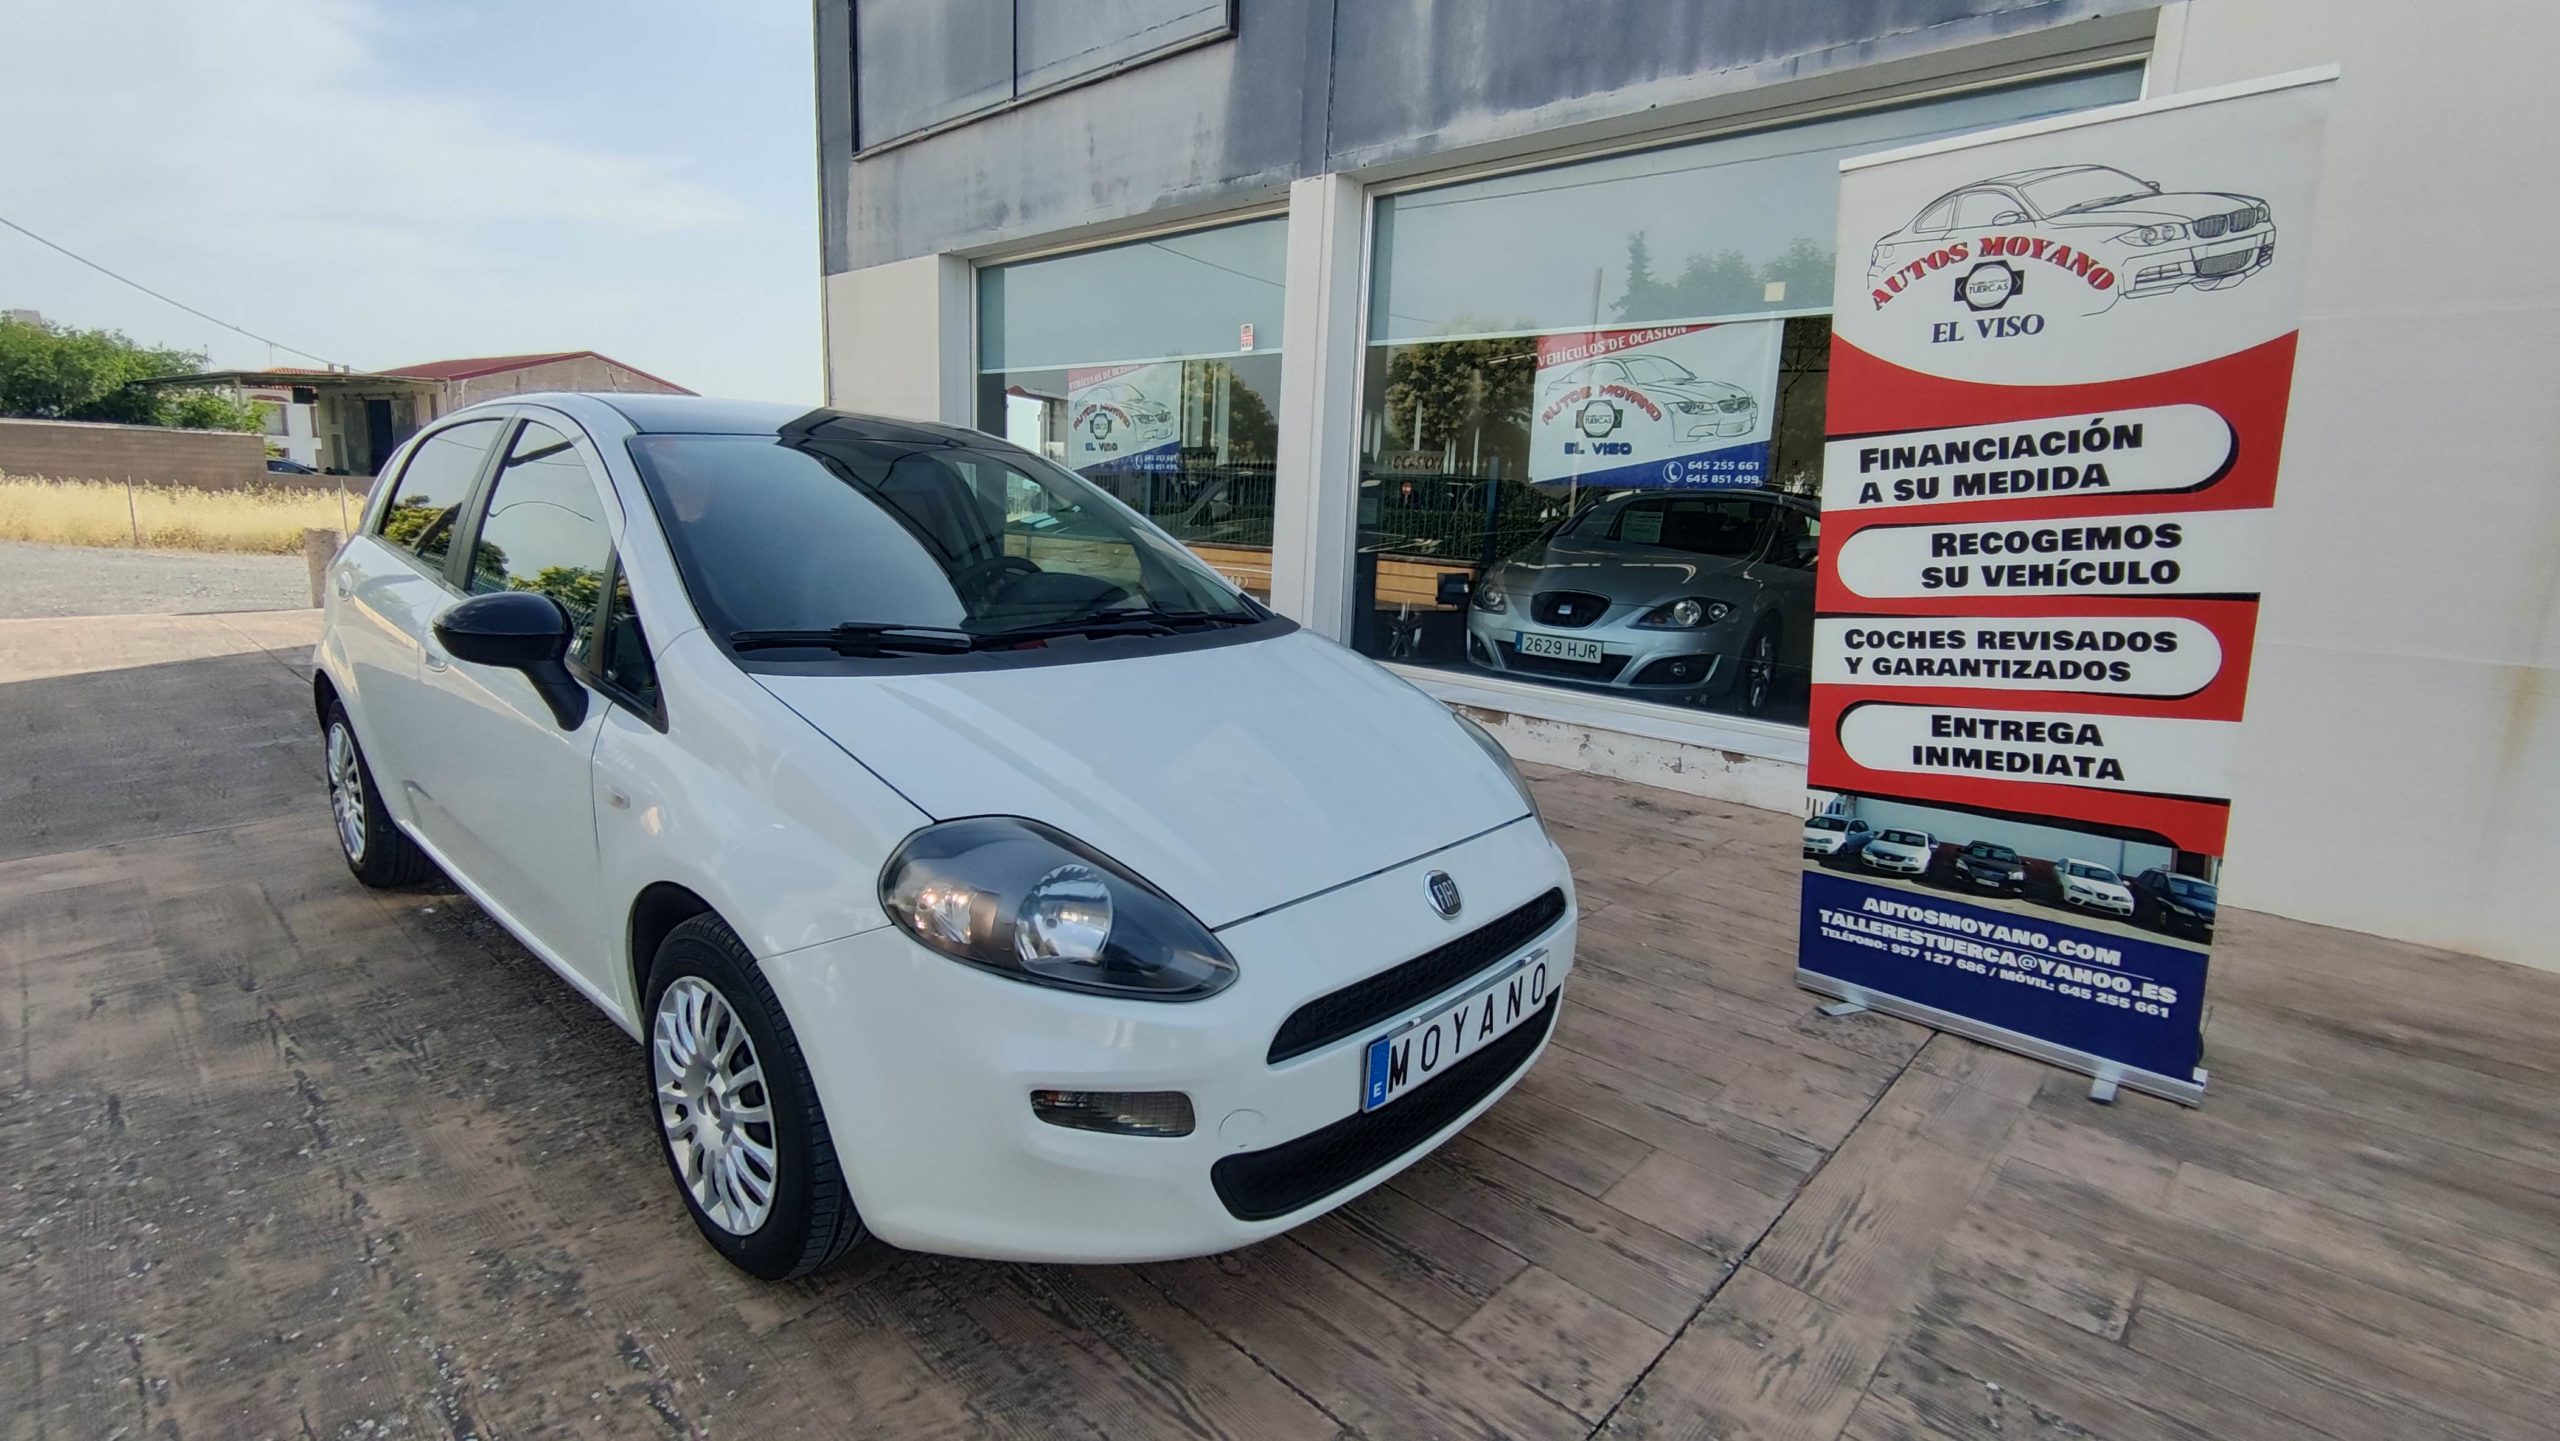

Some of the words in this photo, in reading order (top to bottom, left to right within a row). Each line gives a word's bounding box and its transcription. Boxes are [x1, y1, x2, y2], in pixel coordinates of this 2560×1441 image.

[1869, 241, 1969, 311] AUTOS
[1979, 236, 2115, 291] MOYANO
[1608, 336, 1625, 351] DE
[1931, 321, 1964, 343] EL
[1976, 313, 2045, 338] VISO
[1542, 385, 1593, 426] AUTOS
[1599, 384, 1662, 422] MOYANO
[1564, 442, 1585, 455] EL
[1860, 417, 2144, 474] FINANCIACIÓN
[1686, 474, 1708, 483] 645
[1711, 474, 1731, 483] 851
[1734, 474, 1759, 484] 499
[1688, 461, 1710, 470] 645
[1713, 461, 1735, 470] 255
[1738, 461, 1760, 471] 661
[1859, 481, 1883, 504] A
[1894, 476, 1940, 502] SU
[1953, 462, 2111, 497] MEDIDA
[1931, 523, 2183, 558] RECOGEMOS
[1921, 565, 1969, 589] SU
[1525, 637, 1562, 655] 2629
[1567, 641, 1598, 660] HJR
[1844, 628, 1967, 650] COCHES
[1976, 630, 2178, 653] REVISADOS
[1844, 656, 1864, 675] Y
[1872, 656, 2132, 683] GARANTIZADOS
[1931, 714, 2104, 747] ENTREGA
[1912, 745, 2126, 781] INMEDIATA
[1433, 879, 1460, 910] FIAT
[1862, 897, 2122, 966] AUTOSMOYANO.COM
[1818, 909, 2177, 1004] TALLERESTUERCA@YAHOO.ES
[1891, 943, 1919, 958] 957
[1923, 951, 1953, 966] 127
[1956, 959, 1986, 975] 686
[2058, 983, 2092, 1000] 645
[2096, 992, 2131, 1009] 255
[2134, 1001, 2170, 1018] 661
[1373, 1081, 1383, 1098] E
[1388, 962, 1546, 1094] MOYANO
